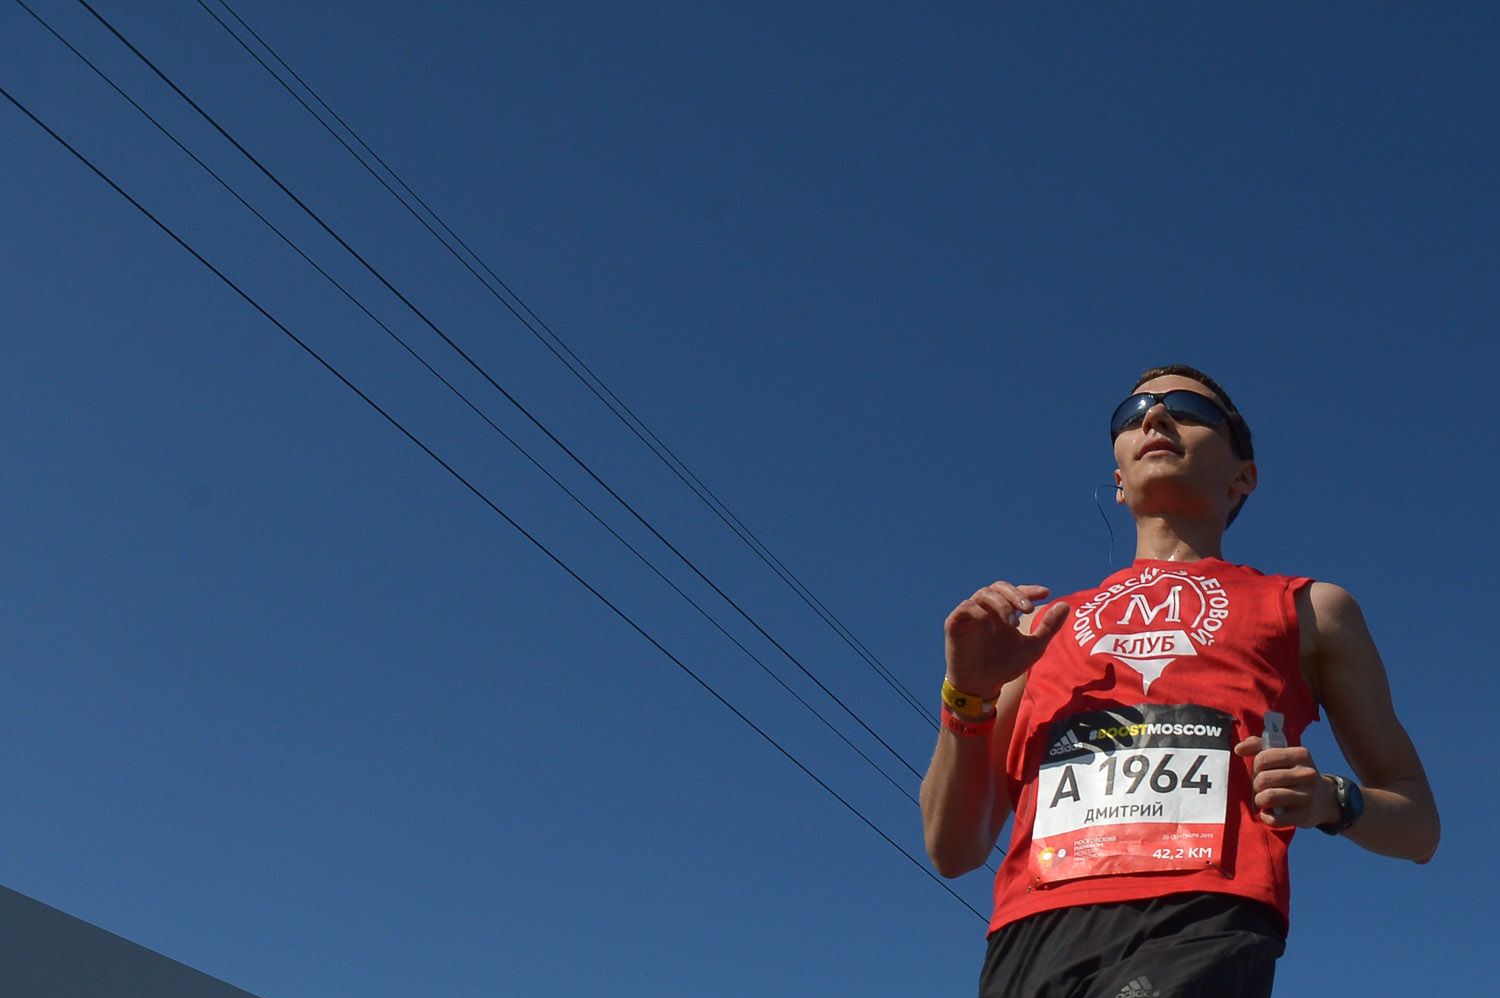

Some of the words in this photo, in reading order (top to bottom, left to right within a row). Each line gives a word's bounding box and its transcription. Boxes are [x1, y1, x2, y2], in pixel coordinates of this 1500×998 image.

[1190, 574, 1230, 648] ЕГОВОЙ
[1112, 637, 1176, 655] КЛУБ
[1089, 723, 1222, 740] #BOOSTMOSCOW
[1098, 753, 1213, 796] 1964
[1084, 801, 1164, 825] ДМИТРИЙ
[1152, 848, 1184, 860] 42,2
